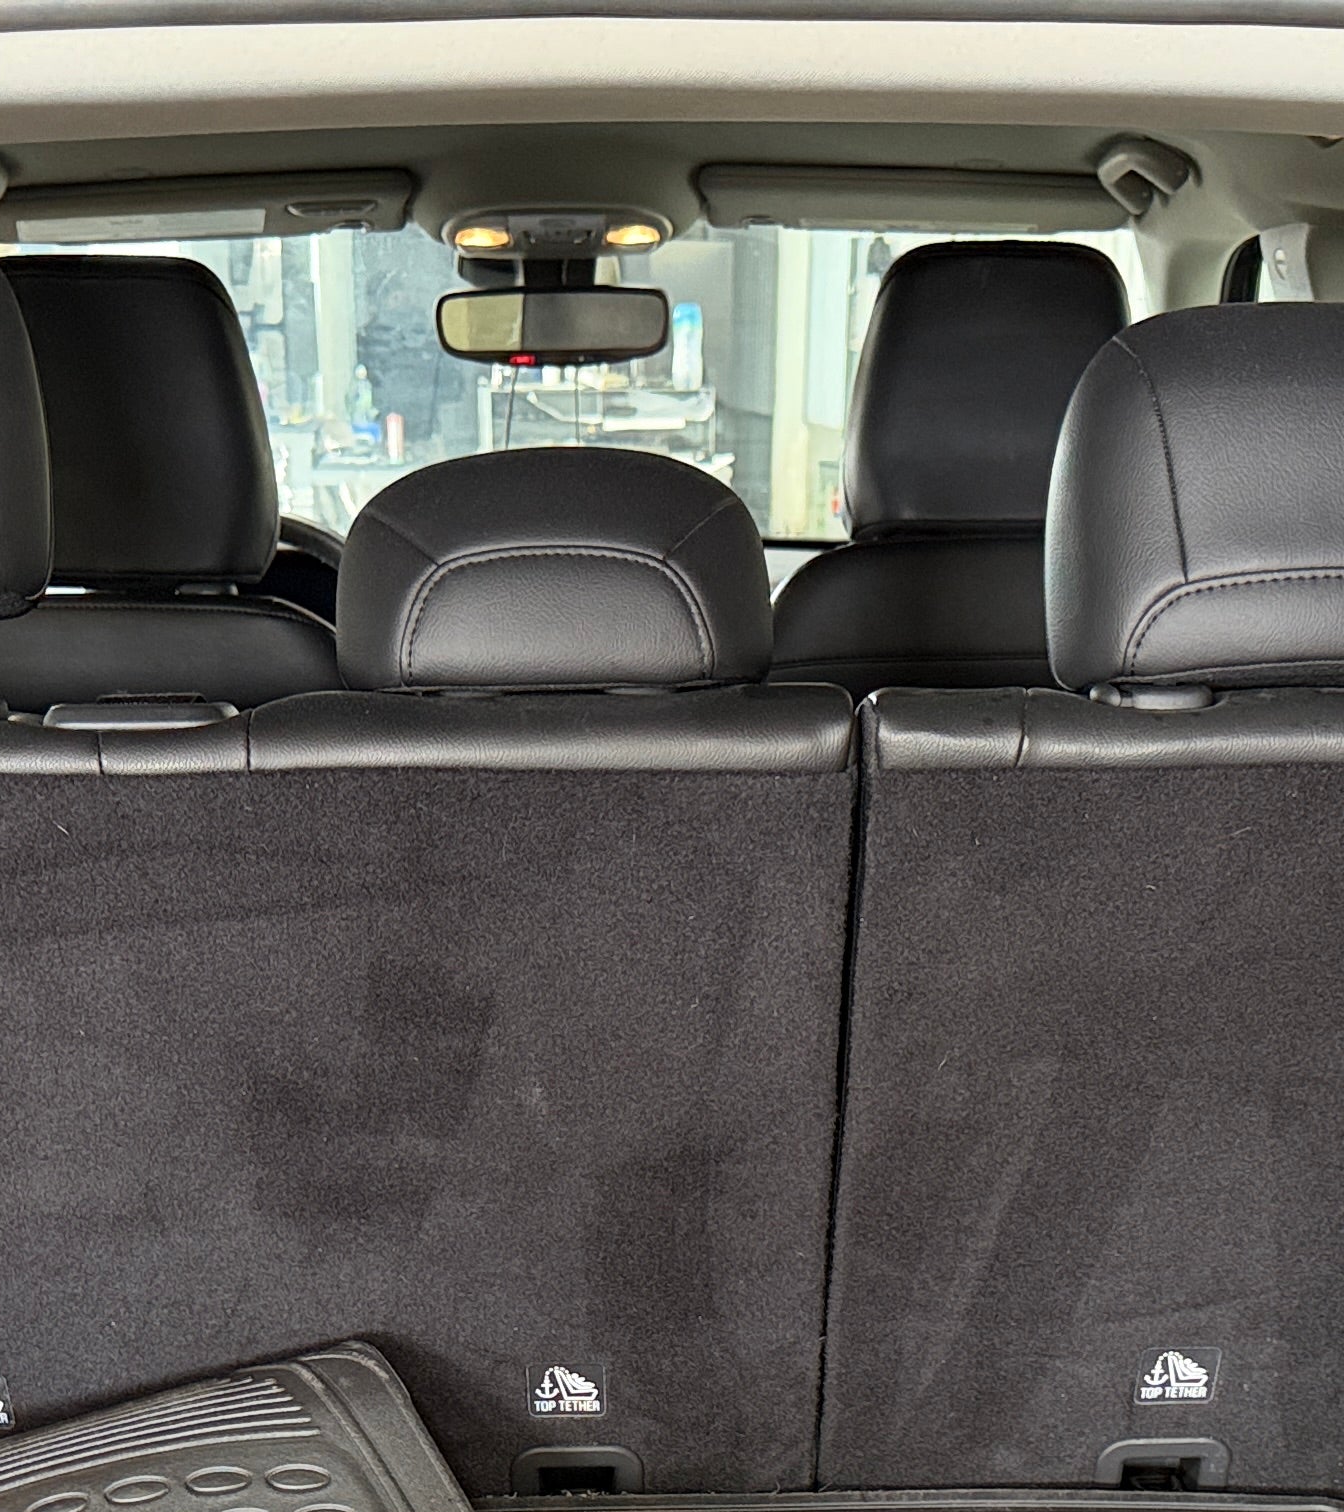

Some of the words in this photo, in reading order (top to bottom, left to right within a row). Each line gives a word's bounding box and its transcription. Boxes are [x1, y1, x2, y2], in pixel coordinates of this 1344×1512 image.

[1140, 1386, 1163, 1399] TOP
[1164, 1386, 1208, 1399] TETHER
[534, 1400, 557, 1412] TOP
[558, 1400, 601, 1412] TETHER
